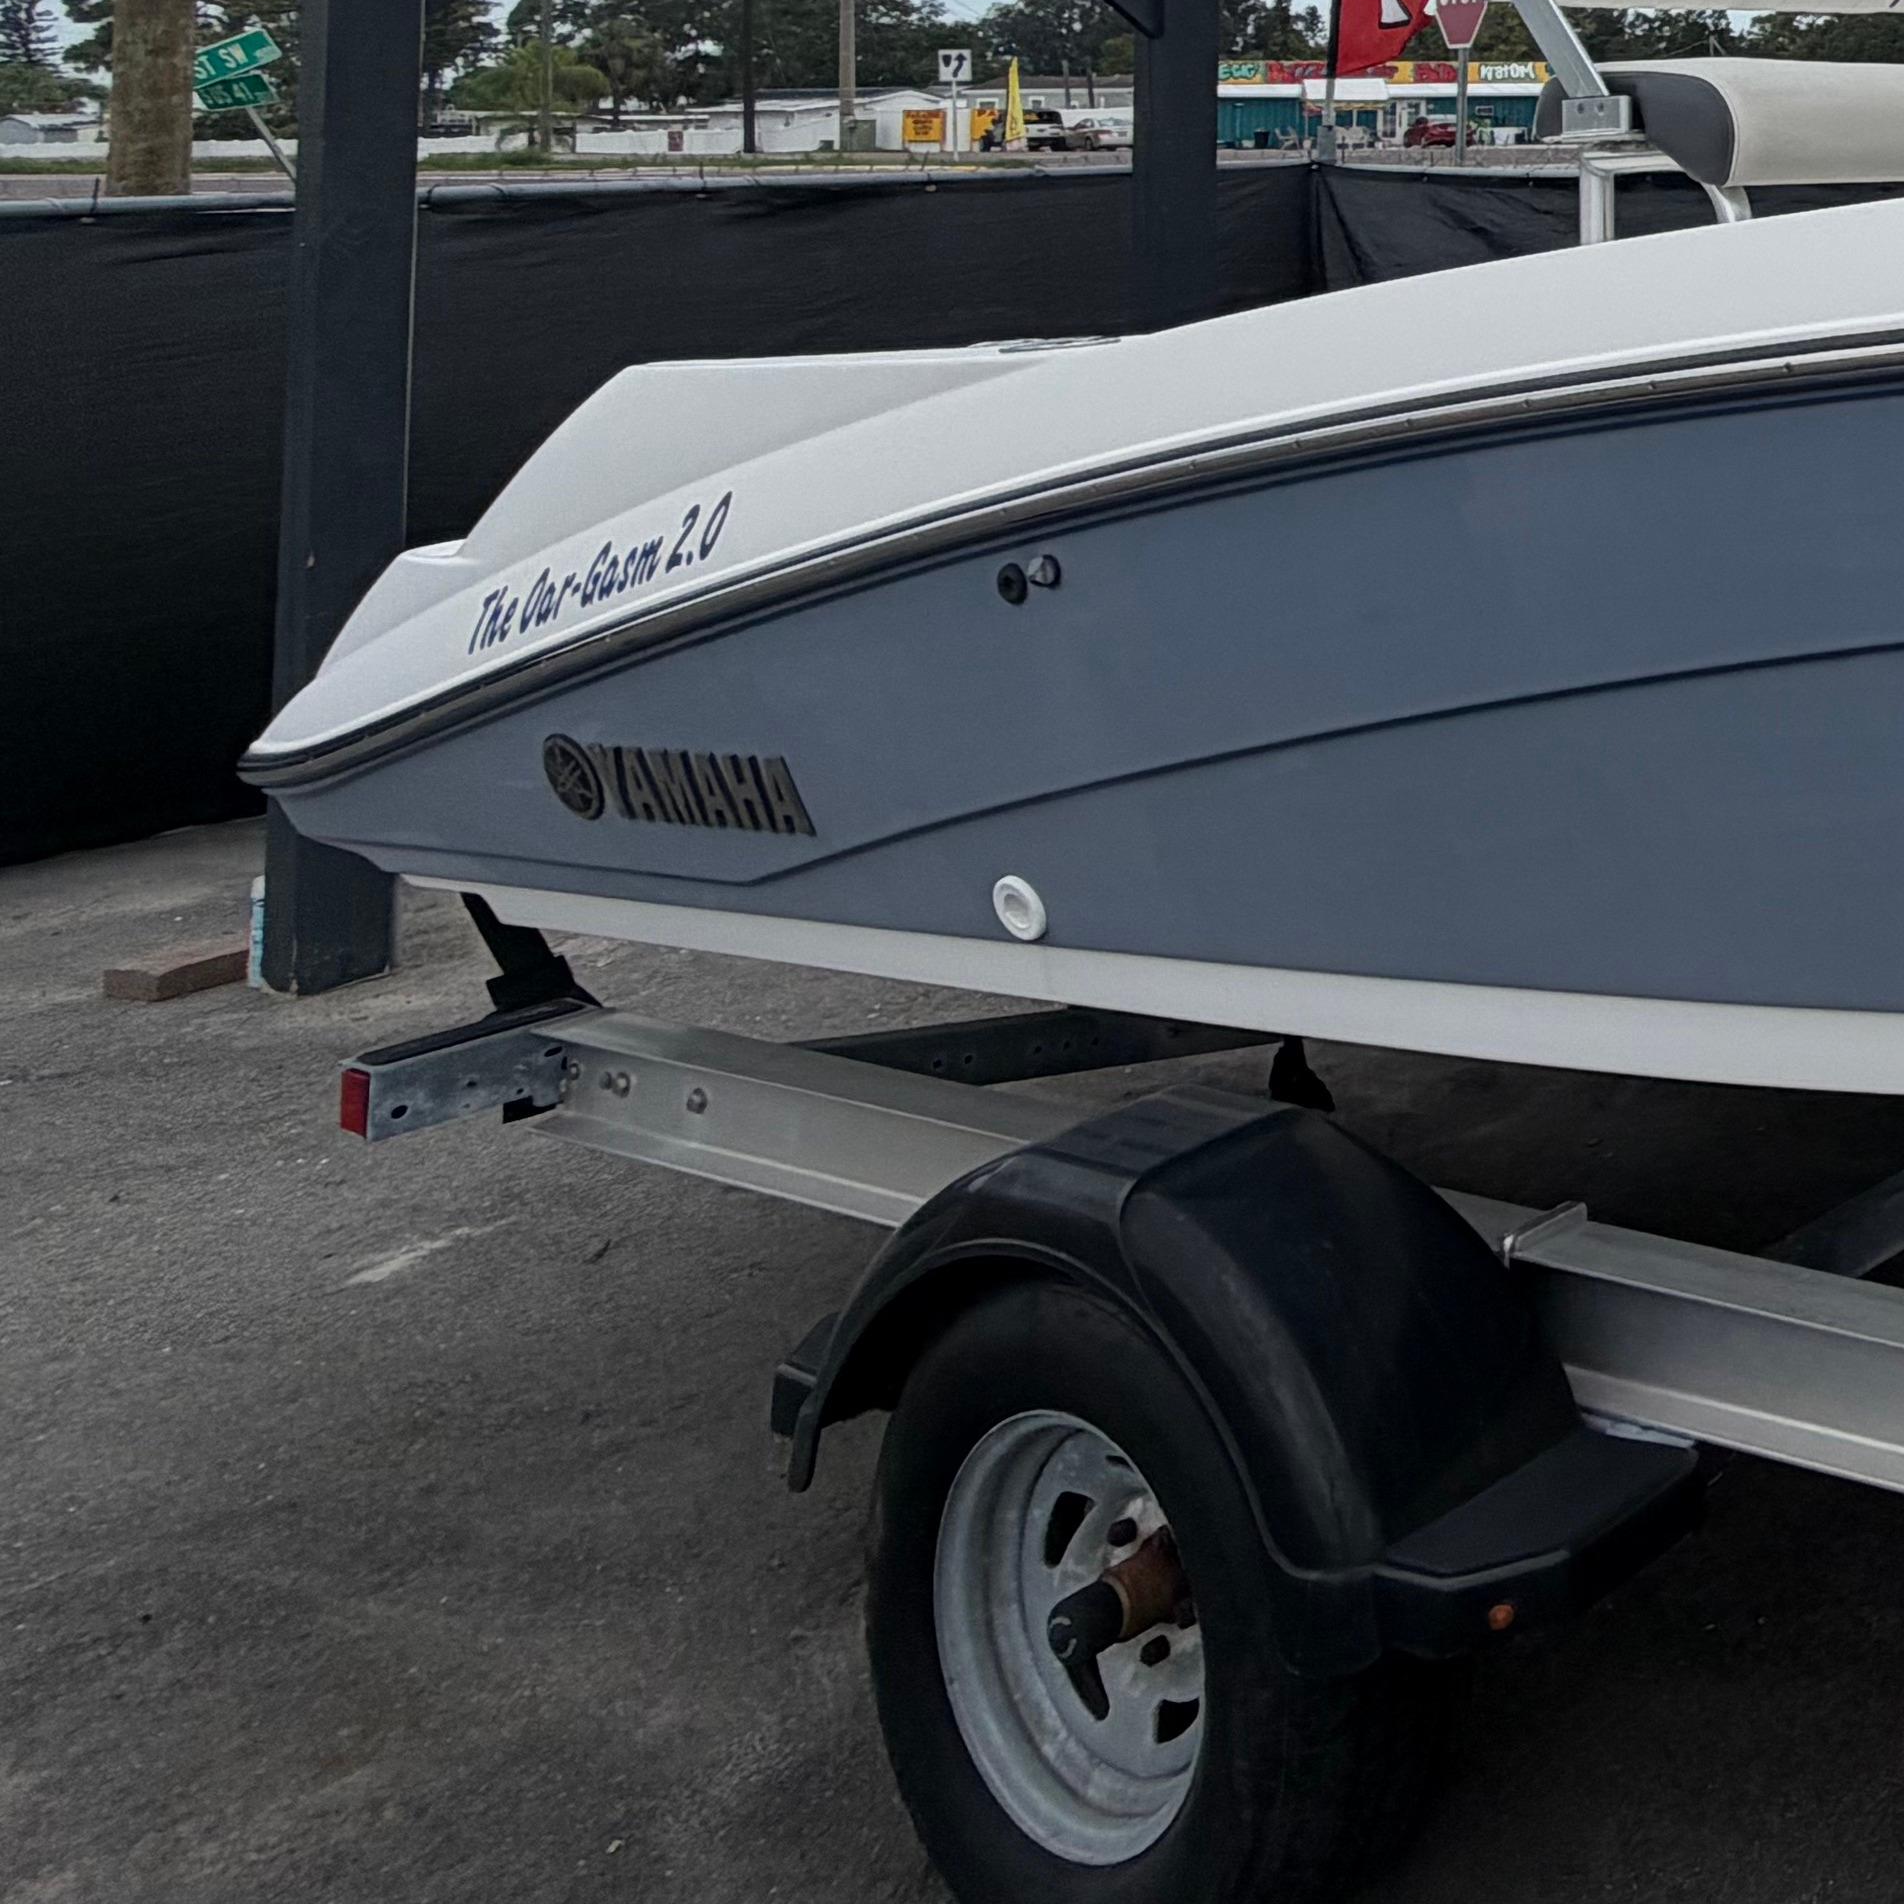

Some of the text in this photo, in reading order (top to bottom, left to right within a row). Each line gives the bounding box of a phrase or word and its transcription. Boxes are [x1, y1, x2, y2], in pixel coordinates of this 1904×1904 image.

[468, 490, 733, 656] The Oar-Gasm 2.0
[587, 741, 818, 838] YAMAHA
